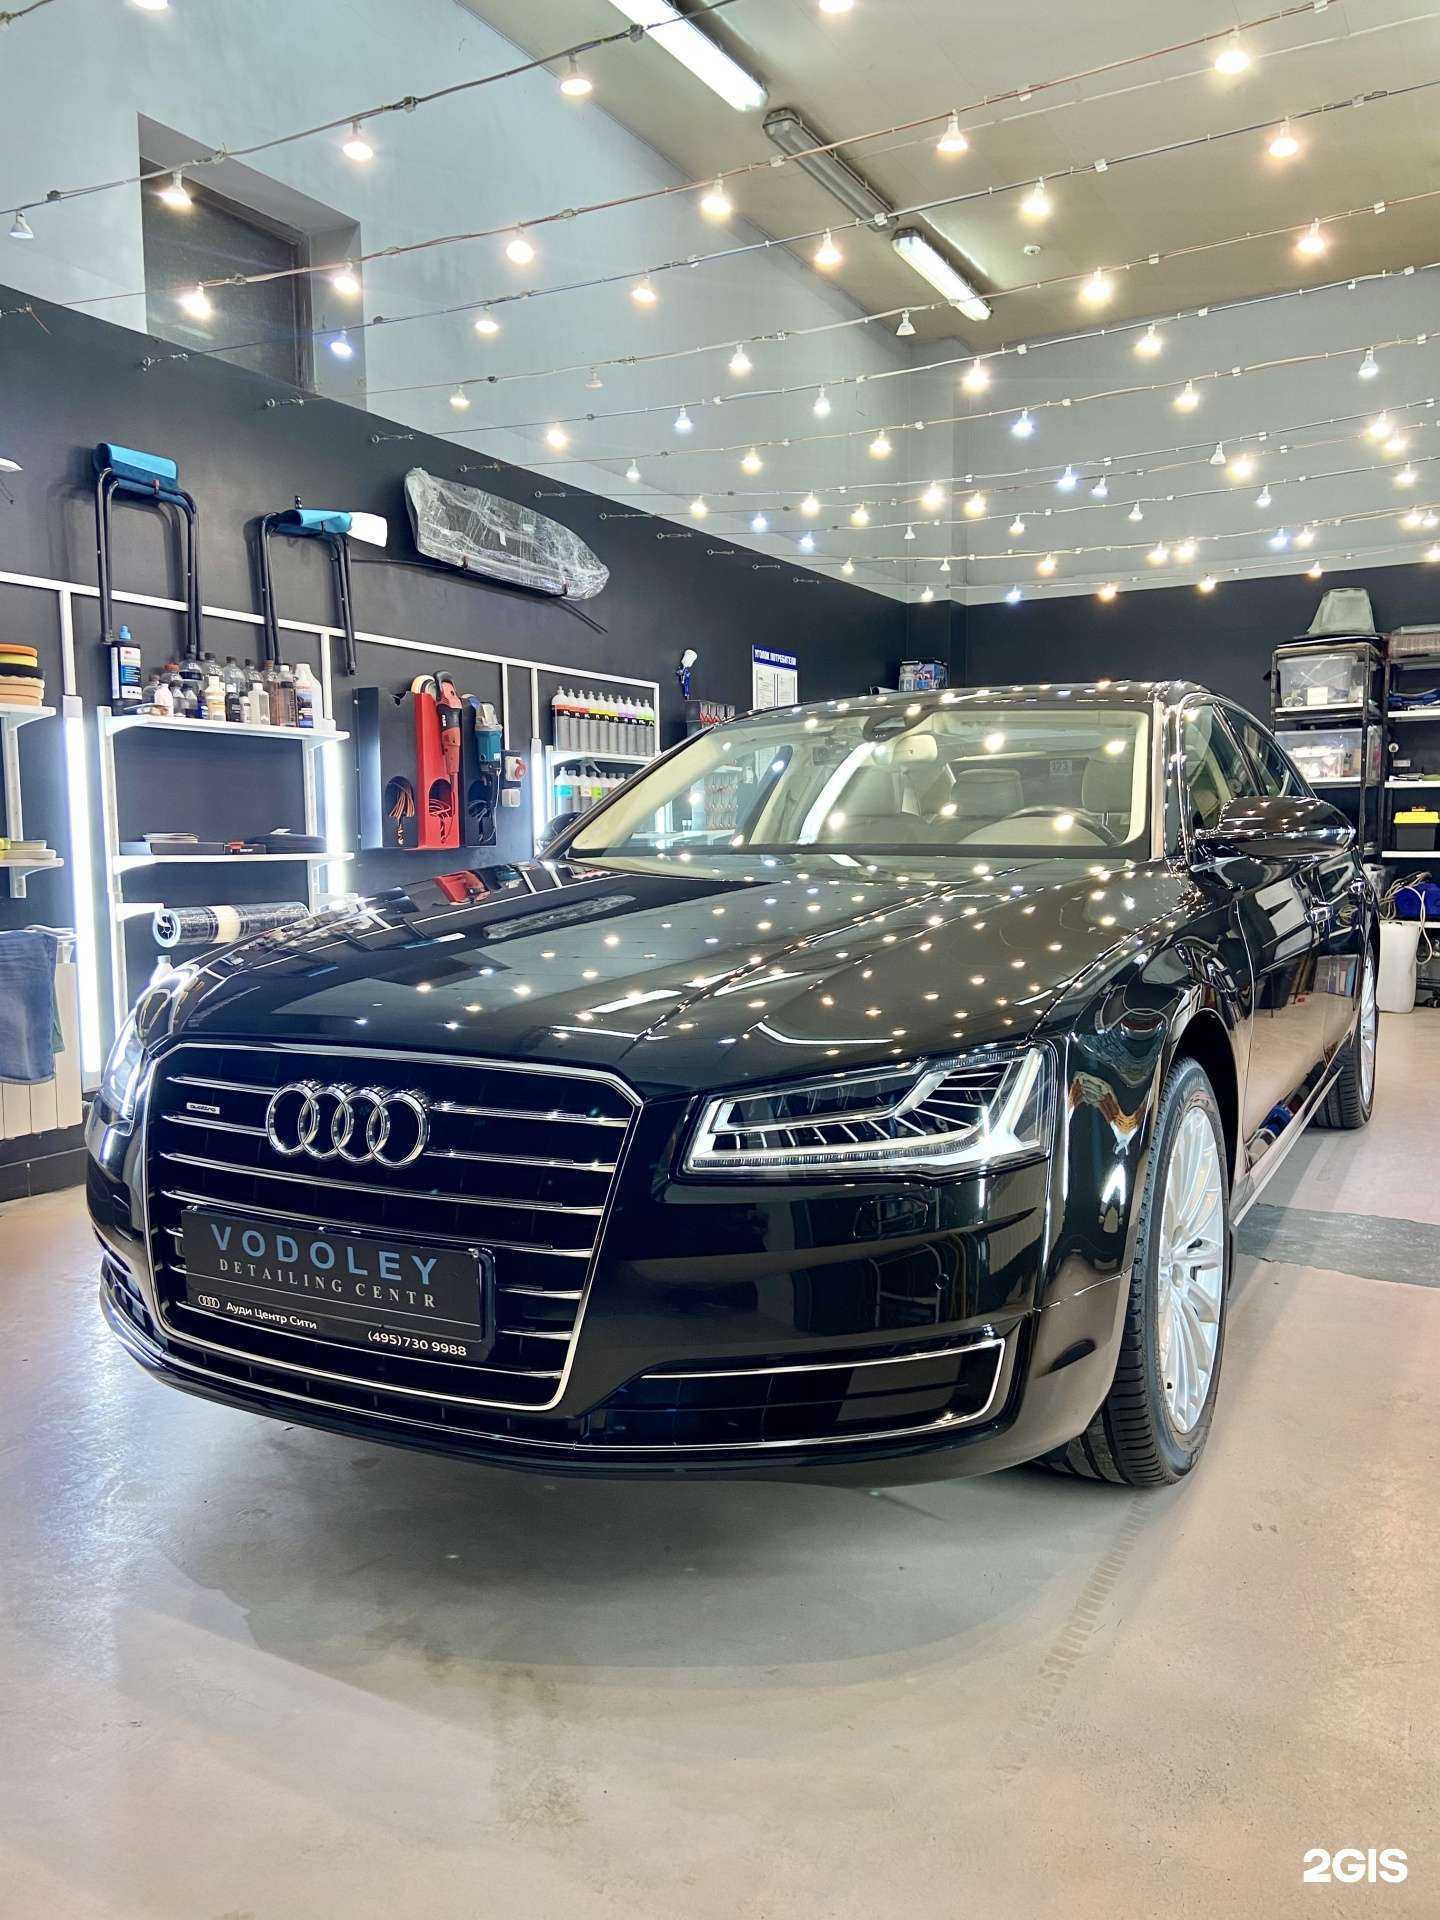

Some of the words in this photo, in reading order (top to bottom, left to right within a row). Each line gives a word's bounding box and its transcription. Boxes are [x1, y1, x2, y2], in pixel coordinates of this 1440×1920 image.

[210, 1223, 439, 1286] VODOLEY
[219, 1258, 343, 1294] DETAILING
[355, 1282, 436, 1309] CENTR
[226, 1302, 253, 1317] Ауди
[255, 1305, 288, 1325] Центр
[289, 1315, 318, 1330] Сити
[432, 1341, 468, 1357] 9988
